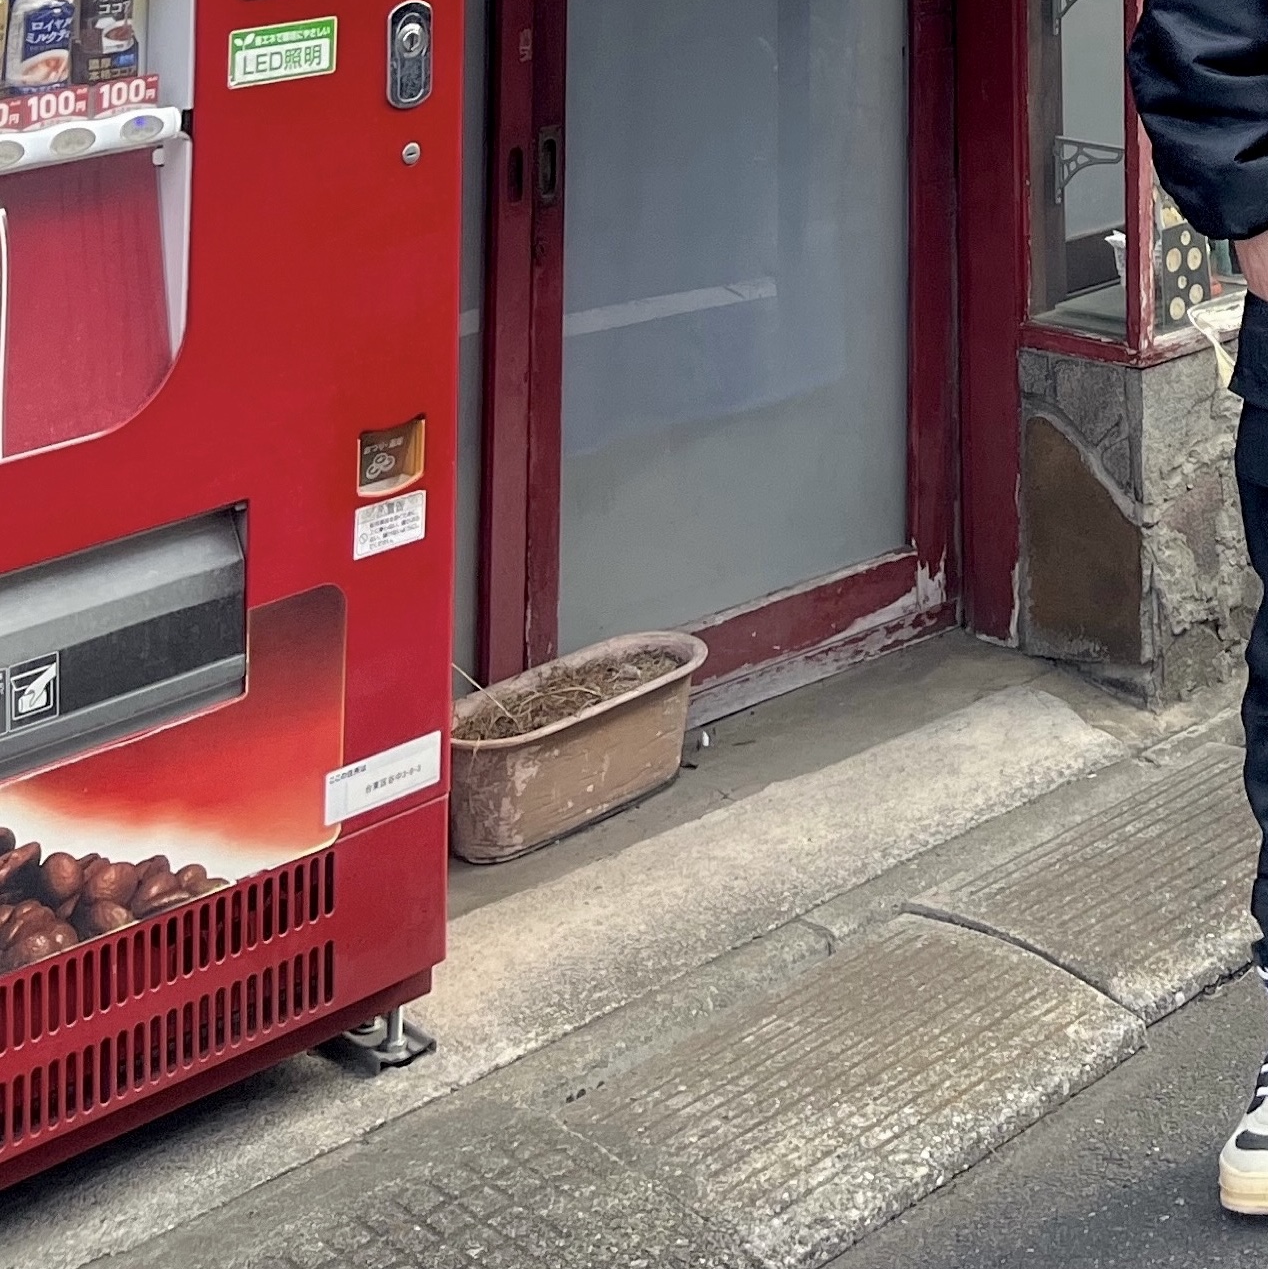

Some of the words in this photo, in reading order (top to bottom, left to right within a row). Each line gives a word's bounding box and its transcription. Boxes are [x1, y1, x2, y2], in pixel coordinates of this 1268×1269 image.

[243, 44, 322, 76] LED照明
[27, 90, 87, 122] 100円
[100, 79, 156, 109] 100円
